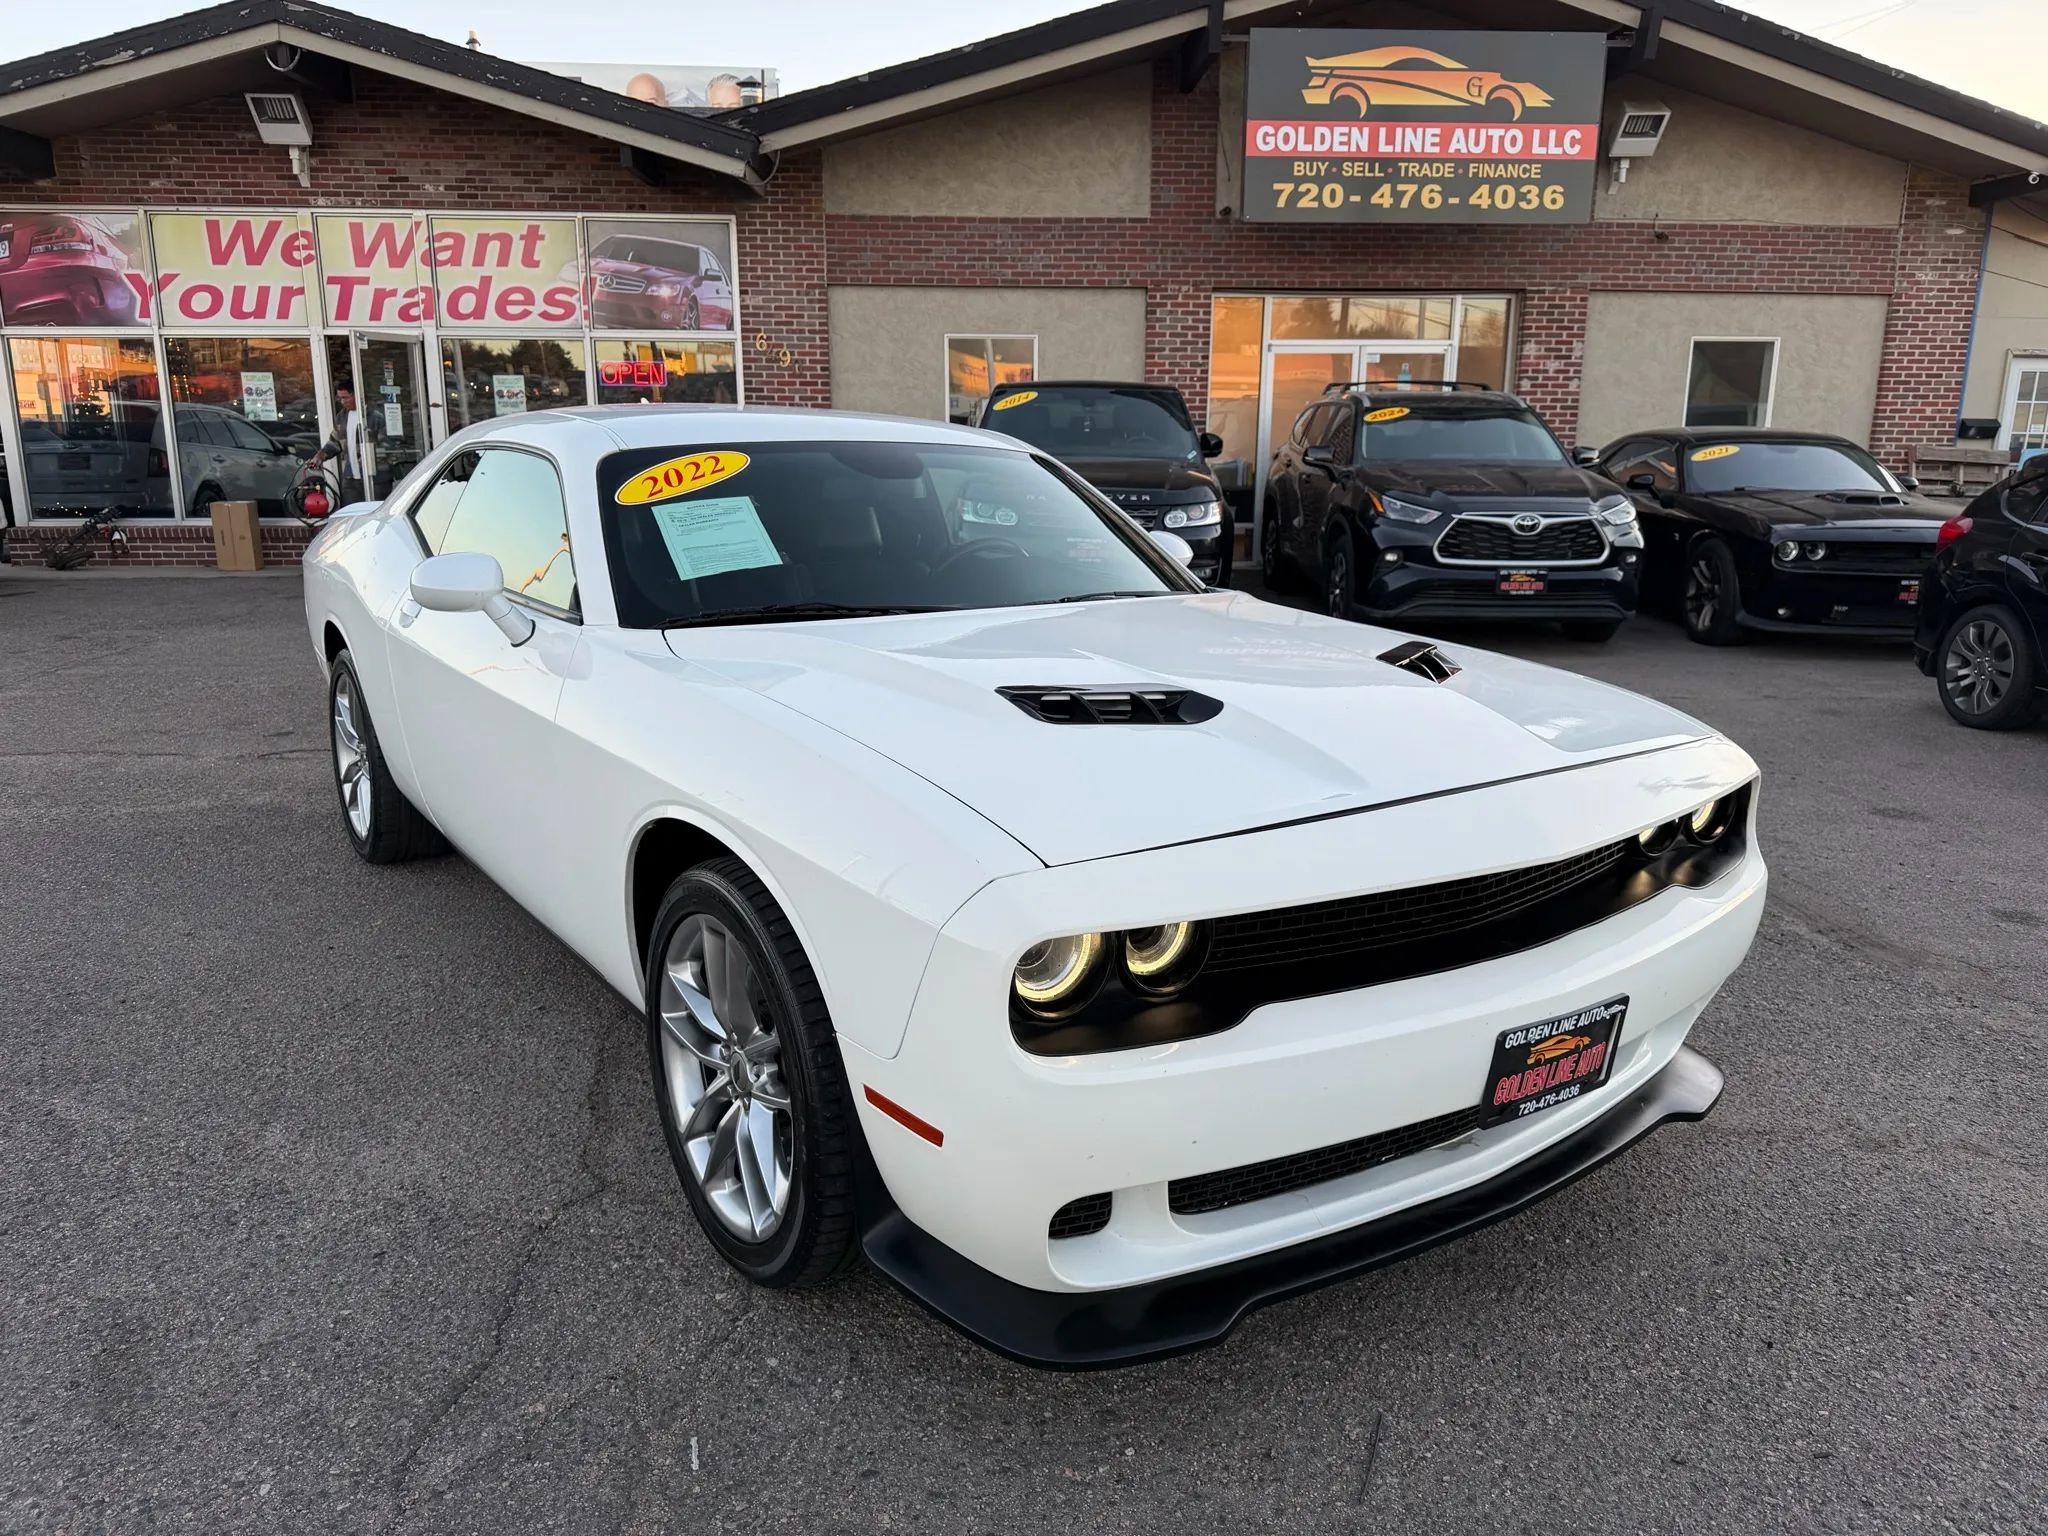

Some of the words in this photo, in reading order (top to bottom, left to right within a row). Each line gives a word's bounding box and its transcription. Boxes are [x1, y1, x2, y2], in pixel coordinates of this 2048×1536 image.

[1256, 125, 1369, 152] GOLDEN
[1378, 127, 1441, 153] LINE
[1448, 128, 1523, 154] AUTO
[1532, 128, 1583, 155] LLC
[1293, 161, 1329, 177] BUY
[1341, 162, 1384, 177] SELL
[1398, 162, 1455, 178] TRADE
[1468, 162, 1542, 178] FINANCE
[204, 219, 316, 267] We
[348, 221, 546, 269] Want
[123, 272, 306, 321] Your
[326, 275, 597, 323] Trades!
[601, 362, 665, 385] OPEN
[1002, 392, 1030, 409] 2014
[1370, 408, 1405, 420] 2024
[1701, 447, 1729, 459] 2021
[641, 455, 726, 498] 2022
[1504, 1022, 1552, 1049] GOLDEN
[1551, 1015, 1578, 1036] LINE
[1577, 1005, 1605, 1028] AUTO
[1493, 1064, 1549, 1106] GOLDEN
[1545, 1053, 1578, 1088] LINE
[1574, 1041, 1607, 1078] AUTO
[1518, 1084, 1580, 1116] 720-476-4036
